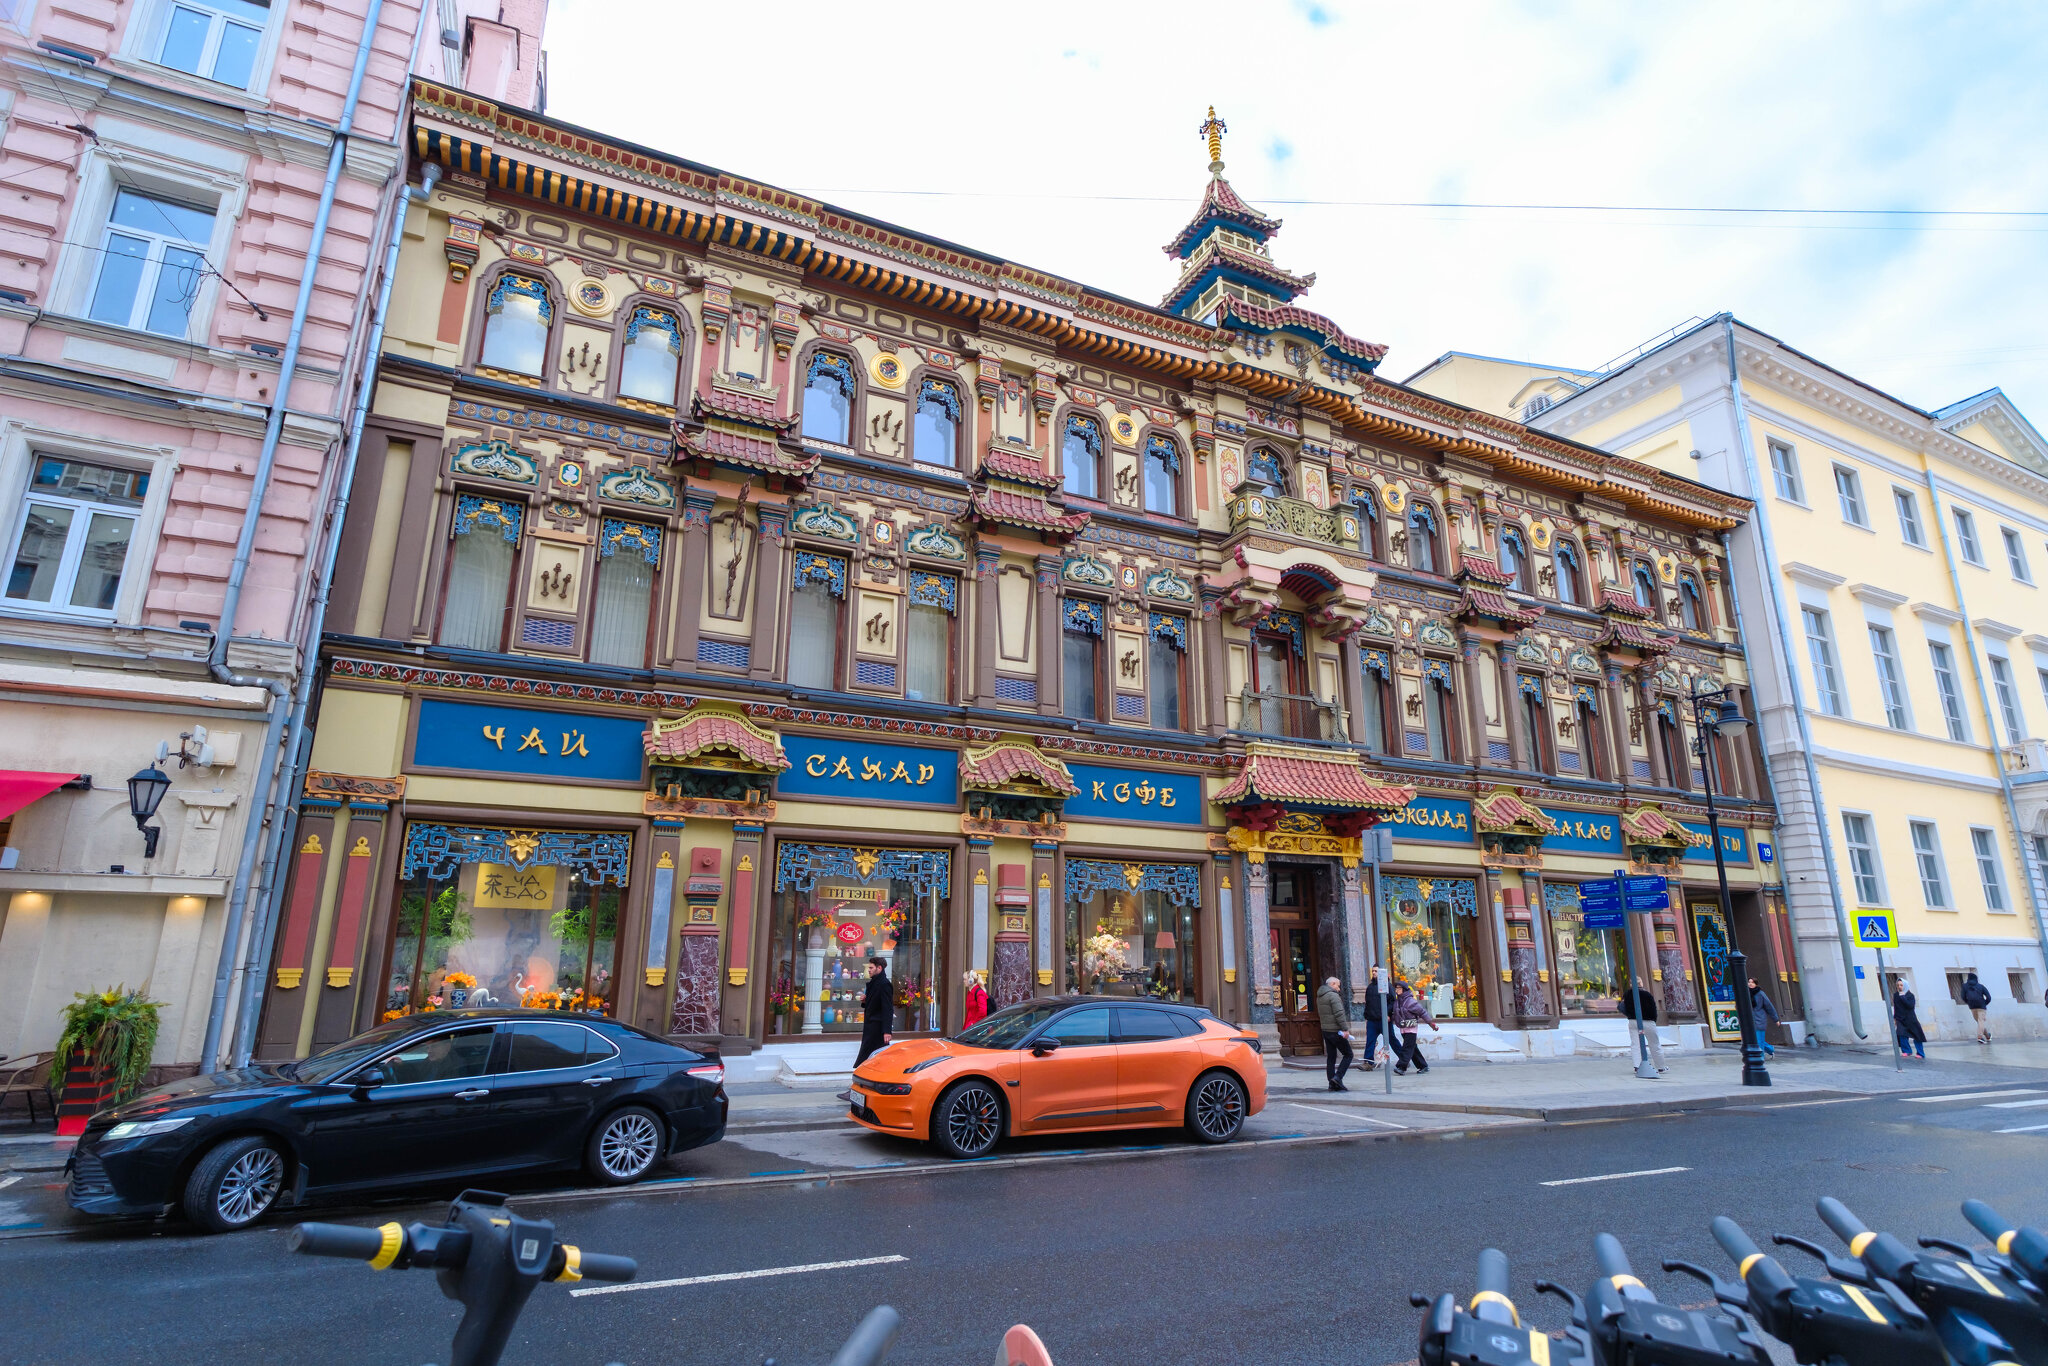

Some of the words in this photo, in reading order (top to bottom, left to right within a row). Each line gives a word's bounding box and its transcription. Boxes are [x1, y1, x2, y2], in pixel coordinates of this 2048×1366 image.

[483, 725, 590, 758] ЧАЙ
[805, 754, 935, 785] САХАР
[1092, 779, 1177, 808] КОФЕ
[1552, 818, 1612, 841] АКАО
[1763, 847, 1771, 857] 19
[483, 874, 503, 899] 茶
[513, 874, 540, 887] ЧА
[502, 885, 547, 901] БАО
[828, 888, 844, 898] ТИ
